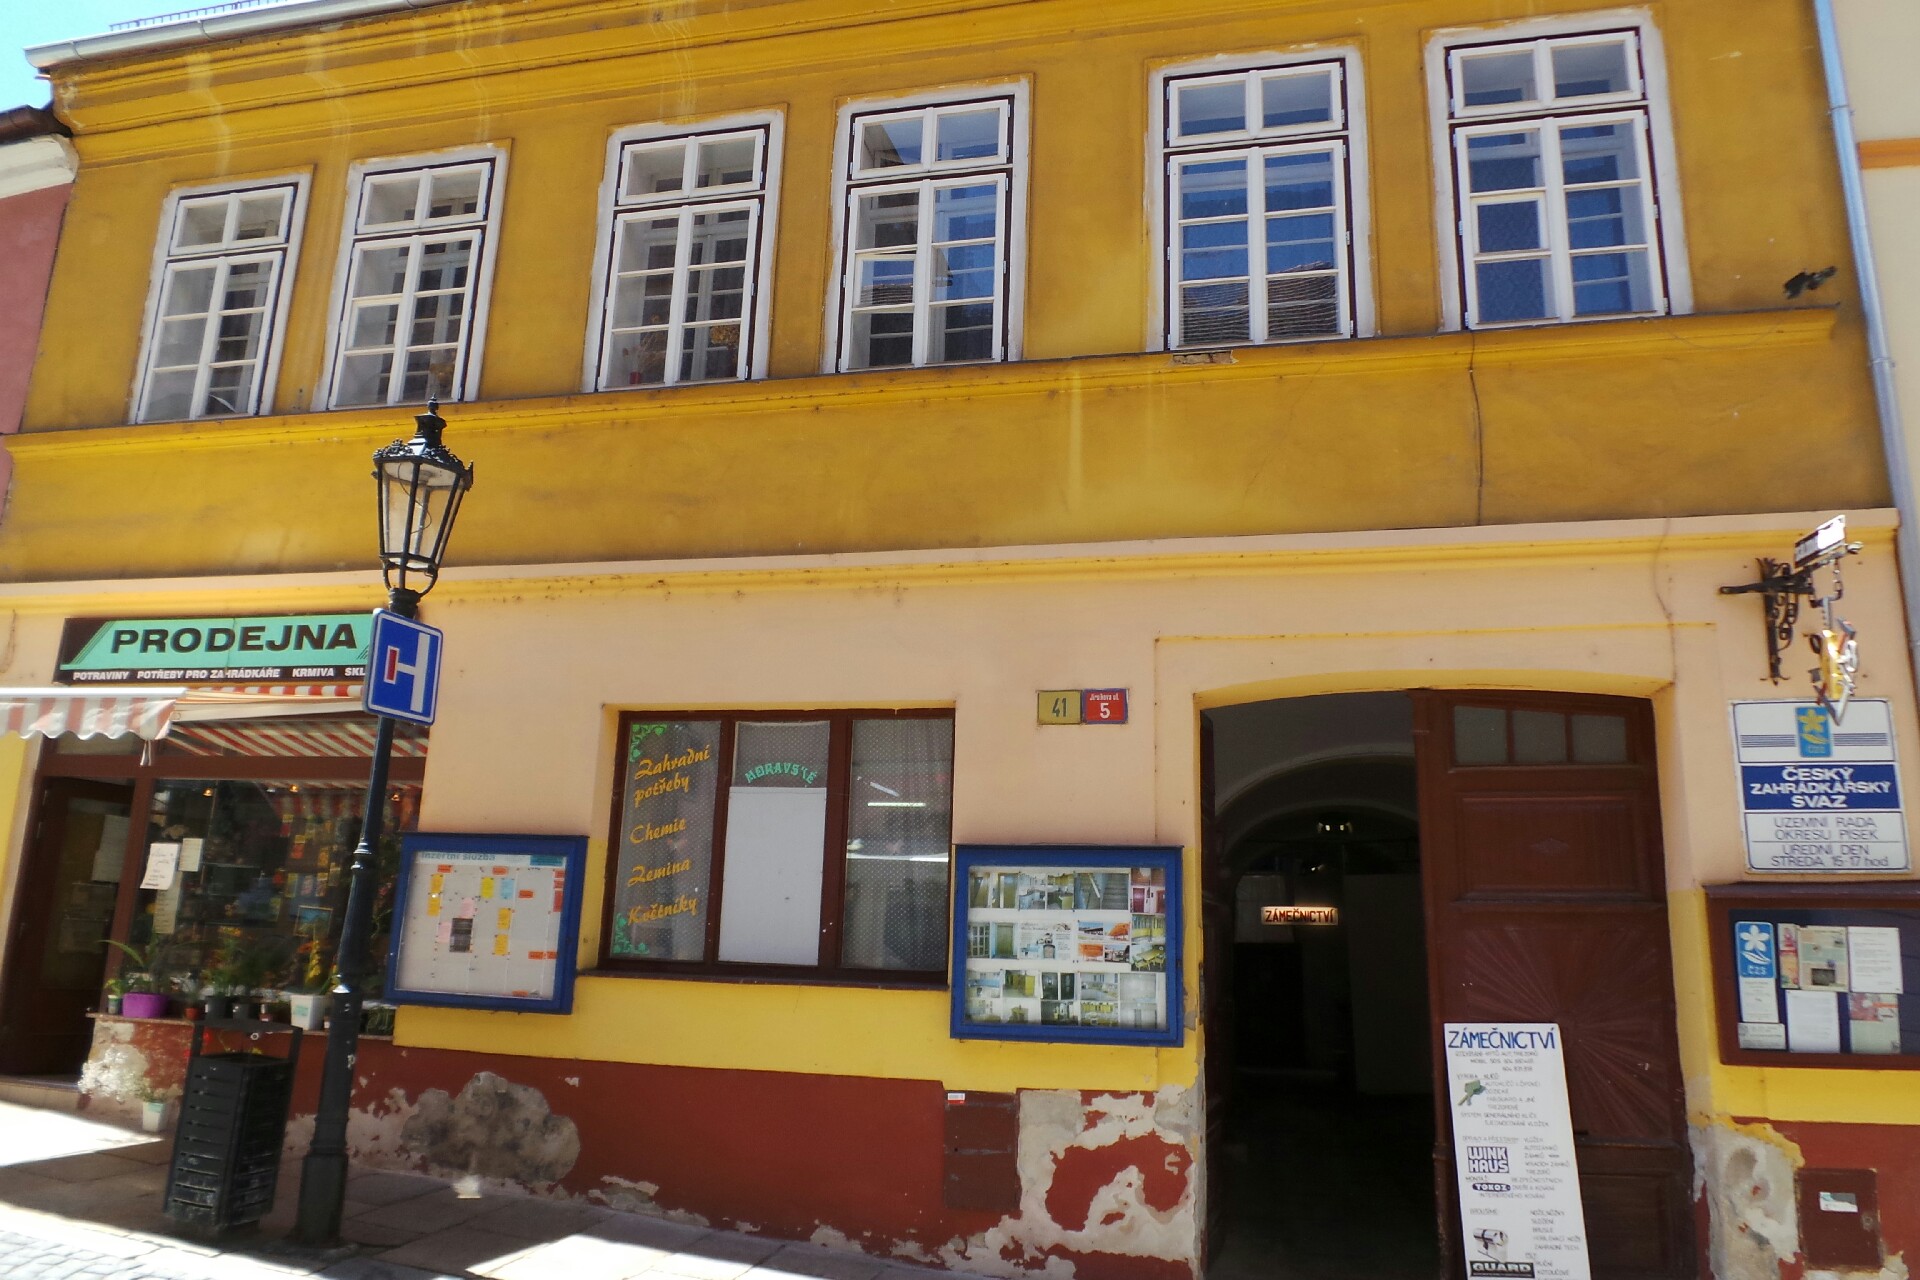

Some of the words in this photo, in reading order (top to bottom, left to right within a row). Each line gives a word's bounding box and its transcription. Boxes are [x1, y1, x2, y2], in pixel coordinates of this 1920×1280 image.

[110, 623, 357, 654] PRODEJNA
[73, 671, 129, 680] POTRAVINY
[137, 668, 184, 680] POTŘEBY
[185, 669, 207, 679] PRO
[292, 668, 334, 677] KRMIVA
[344, 667, 365, 676] SKL
[1052, 697, 1067, 718] 41
[1100, 702, 1110, 719] 5
[635, 744, 711, 780] Zahradní
[1782, 766, 1854, 781] ČESKÝ
[634, 772, 690, 808] potřeby
[1791, 794, 1848, 808] SVAZ
[629, 818, 687, 844] Chemie
[1775, 829, 1831, 840] OKRESU
[1841, 845, 1869, 855] DEN
[627, 858, 692, 887] Zemina
[628, 894, 698, 926] Květníky
[1265, 908, 1335, 923] ZÁMEČNICTVÍ
[1448, 1027, 1556, 1049] ZÁMEČNICTVÍ
[1468, 1147, 1507, 1160] WINK
[1469, 1160, 1509, 1173] HAUS
[1475, 1183, 1507, 1191] TOKOZ
[1472, 1262, 1531, 1272] GUARD
